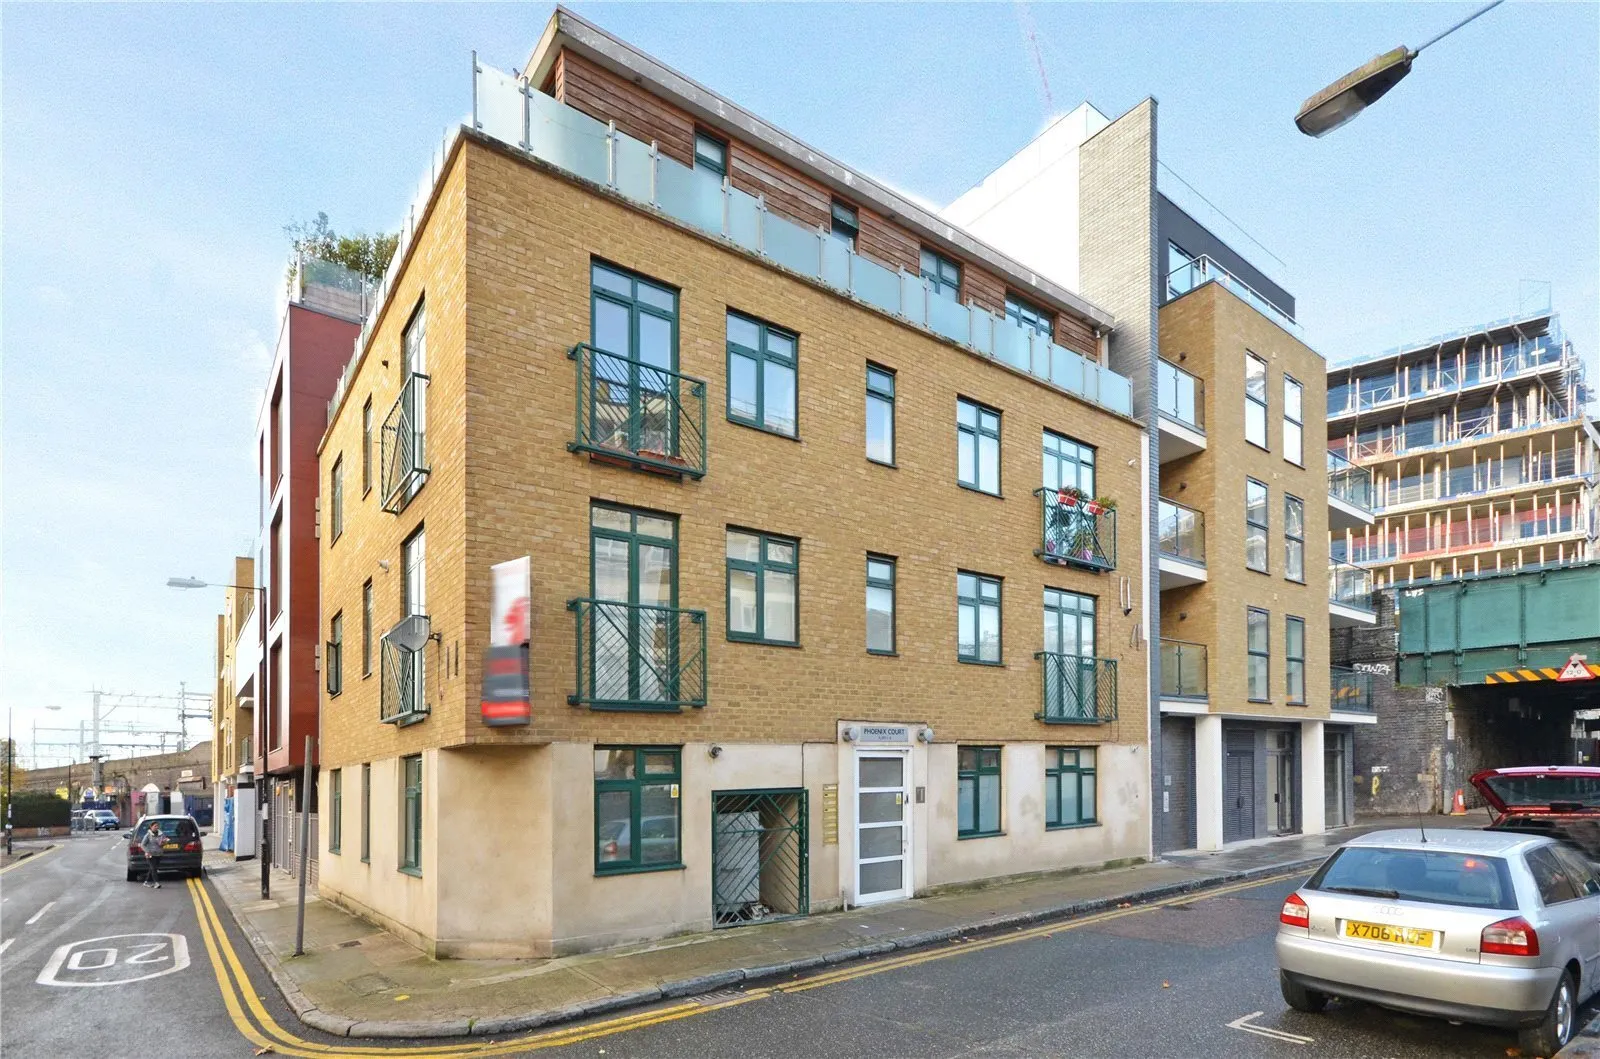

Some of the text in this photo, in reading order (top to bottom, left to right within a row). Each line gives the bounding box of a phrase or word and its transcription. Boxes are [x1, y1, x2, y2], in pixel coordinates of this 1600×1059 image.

[887, 728, 905, 736] COURT
[1351, 923, 1391, 940] X706
[66, 942, 169, 970] 20
